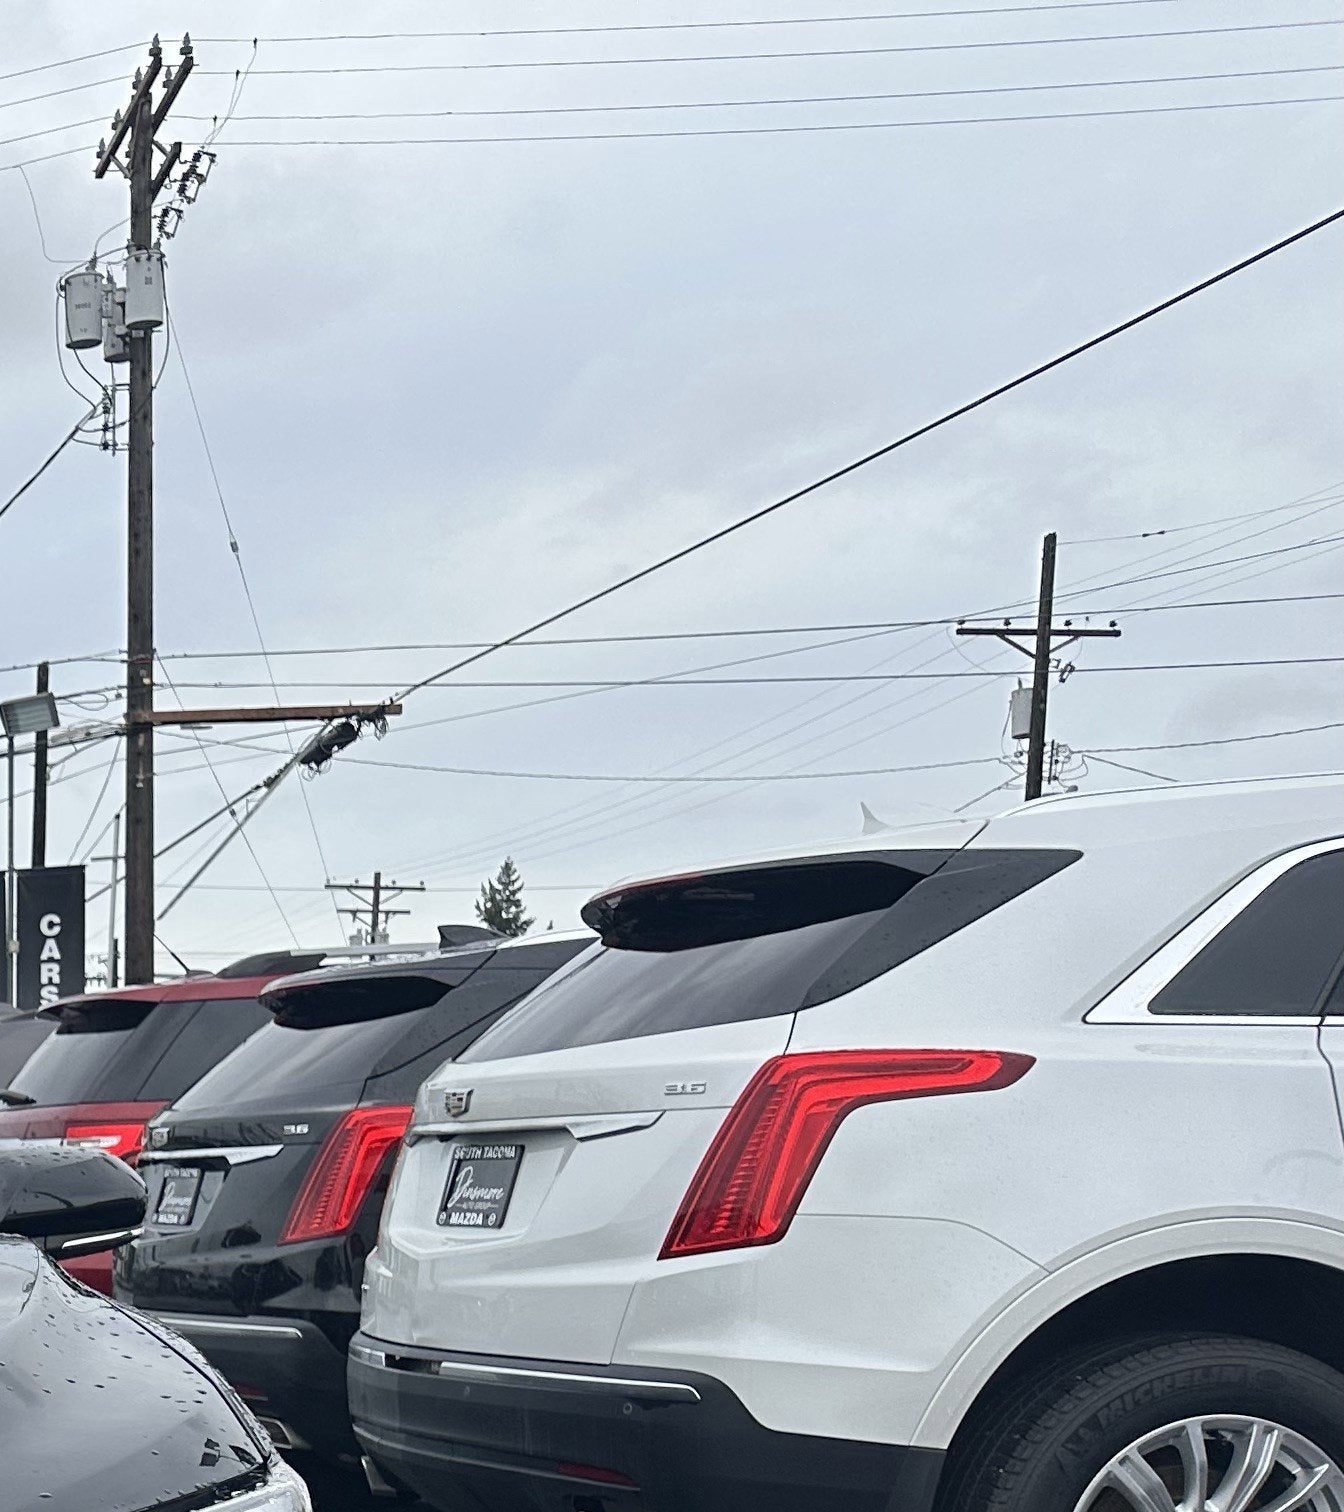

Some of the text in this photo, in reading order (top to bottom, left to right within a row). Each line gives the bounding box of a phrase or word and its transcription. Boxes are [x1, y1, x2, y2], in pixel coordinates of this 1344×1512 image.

[40, 913, 61, 1006] CARS
[483, 1145, 516, 1158] TACOMA
[450, 1212, 483, 1225] MAZDA
